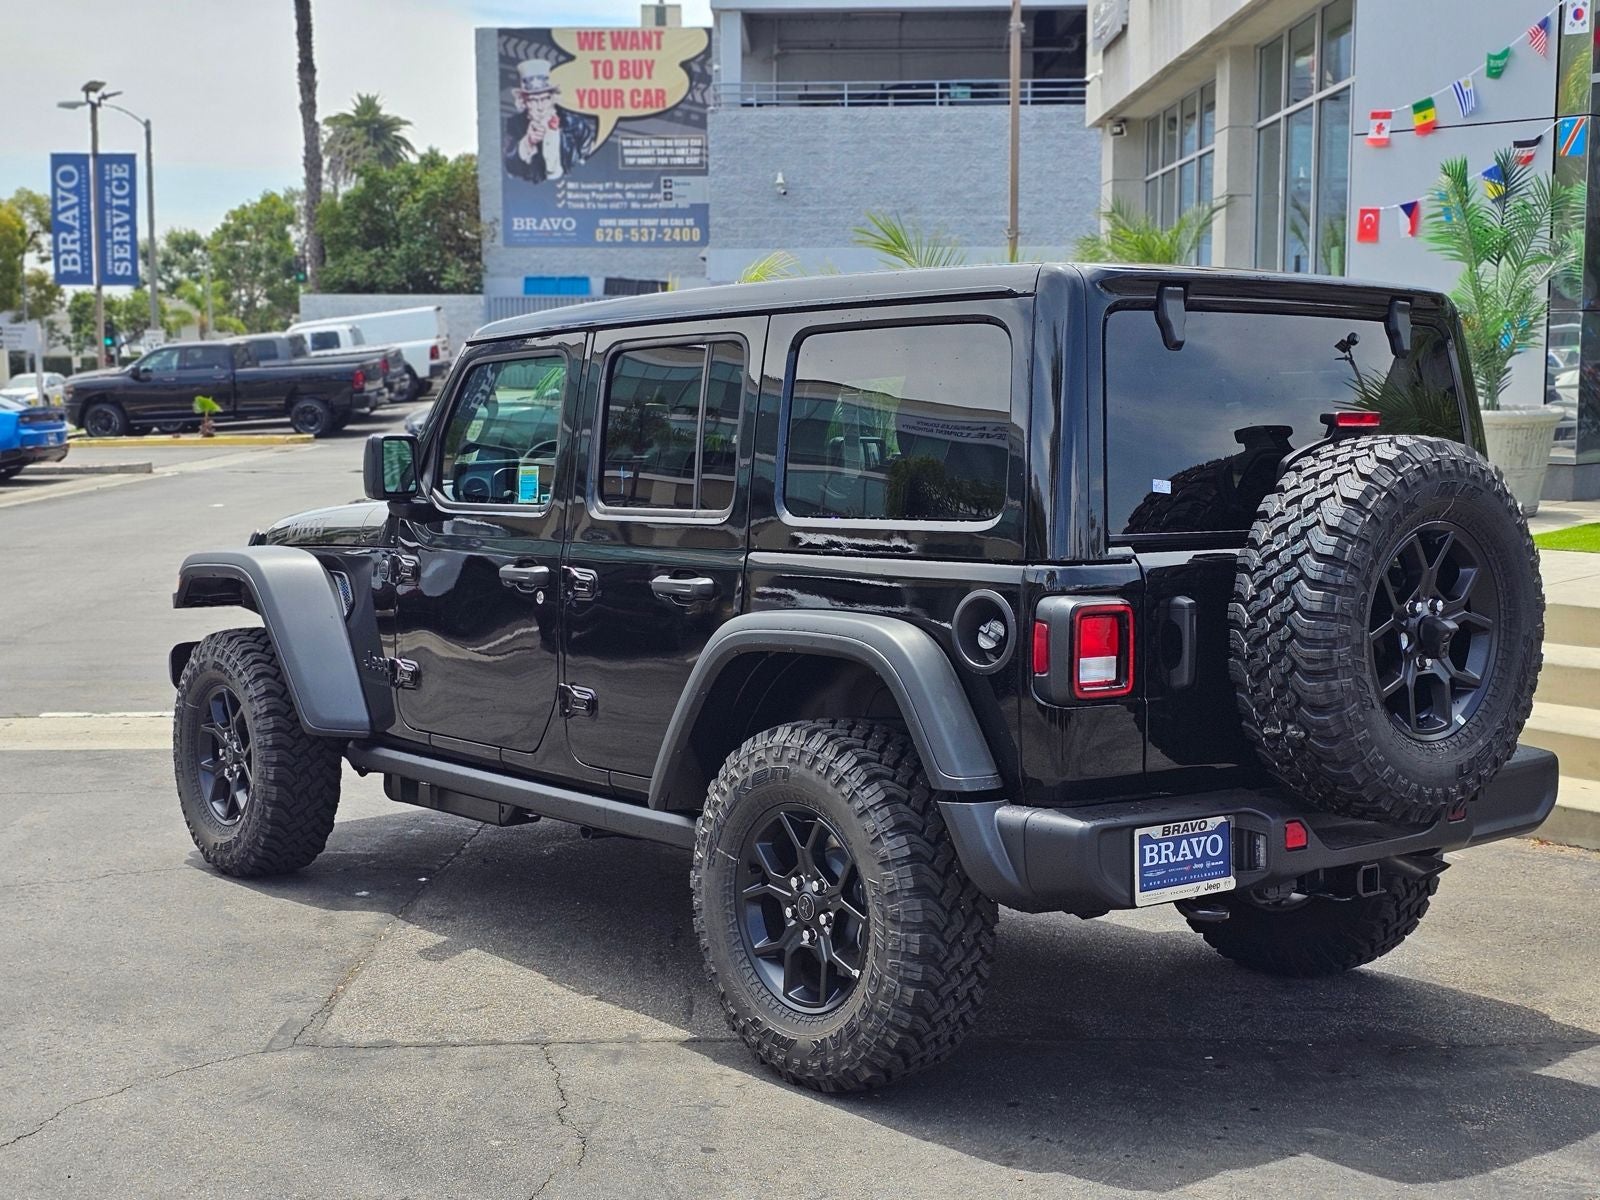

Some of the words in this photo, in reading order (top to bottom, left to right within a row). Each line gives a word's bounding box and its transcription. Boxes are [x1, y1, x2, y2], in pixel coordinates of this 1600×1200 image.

[576, 31, 606, 51] WE
[610, 31, 664, 51] WANT
[590, 59, 614, 80] TO
[619, 59, 655, 80] BUY
[576, 88, 626, 109] YOUR
[630, 88, 667, 109] CAR
[56, 164, 82, 274] BRAVO
[112, 164, 132, 276] SERVICE
[512, 217, 577, 231] BRAVO
[595, 228, 701, 241] 626-537-2400
[363, 650, 390, 687] Jeep
[1161, 820, 1208, 836] BRAVO
[1143, 834, 1223, 867] BRAVO
[1204, 882, 1221, 891] Jeep
